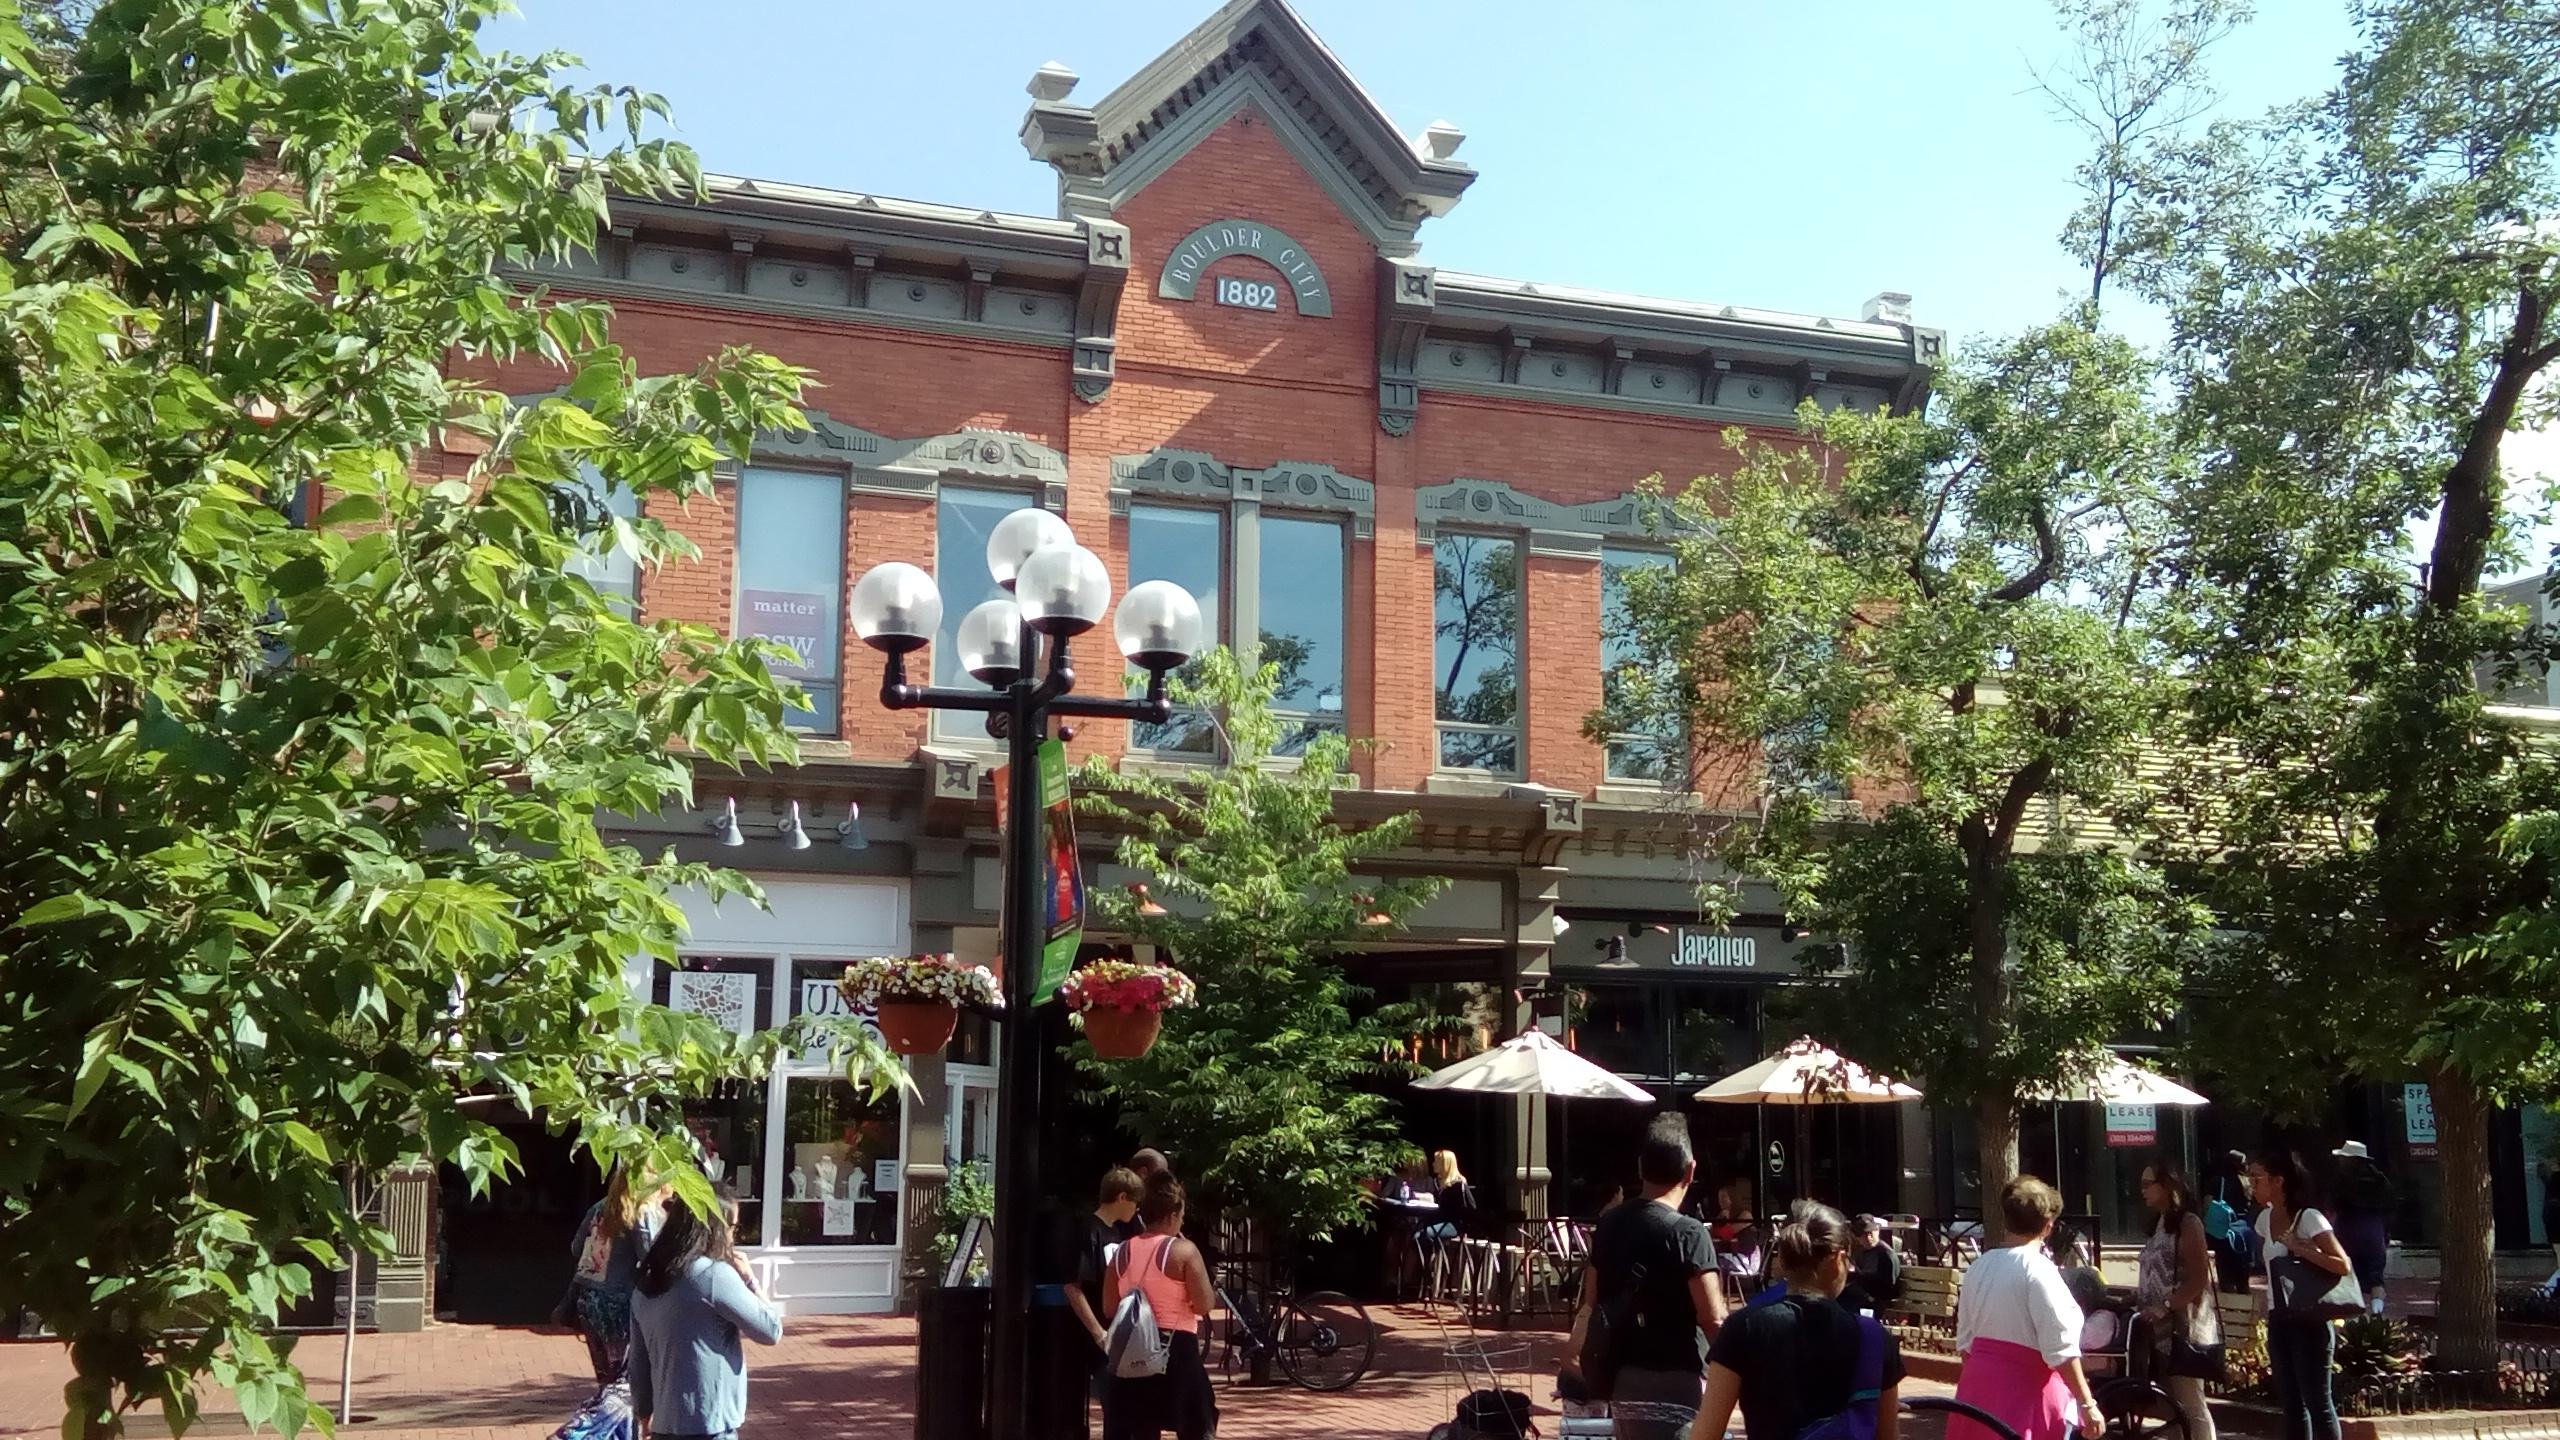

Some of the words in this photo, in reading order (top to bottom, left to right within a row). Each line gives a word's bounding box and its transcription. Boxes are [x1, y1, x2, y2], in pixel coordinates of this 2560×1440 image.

[1172, 228, 1262, 284] BOULDER
[1279, 248, 1322, 300] CITY
[1219, 278, 1277, 309] 1882
[753, 600, 817, 616] matter
[1671, 927, 1756, 967] Japango
[2109, 1106, 2153, 1117] LEASE
